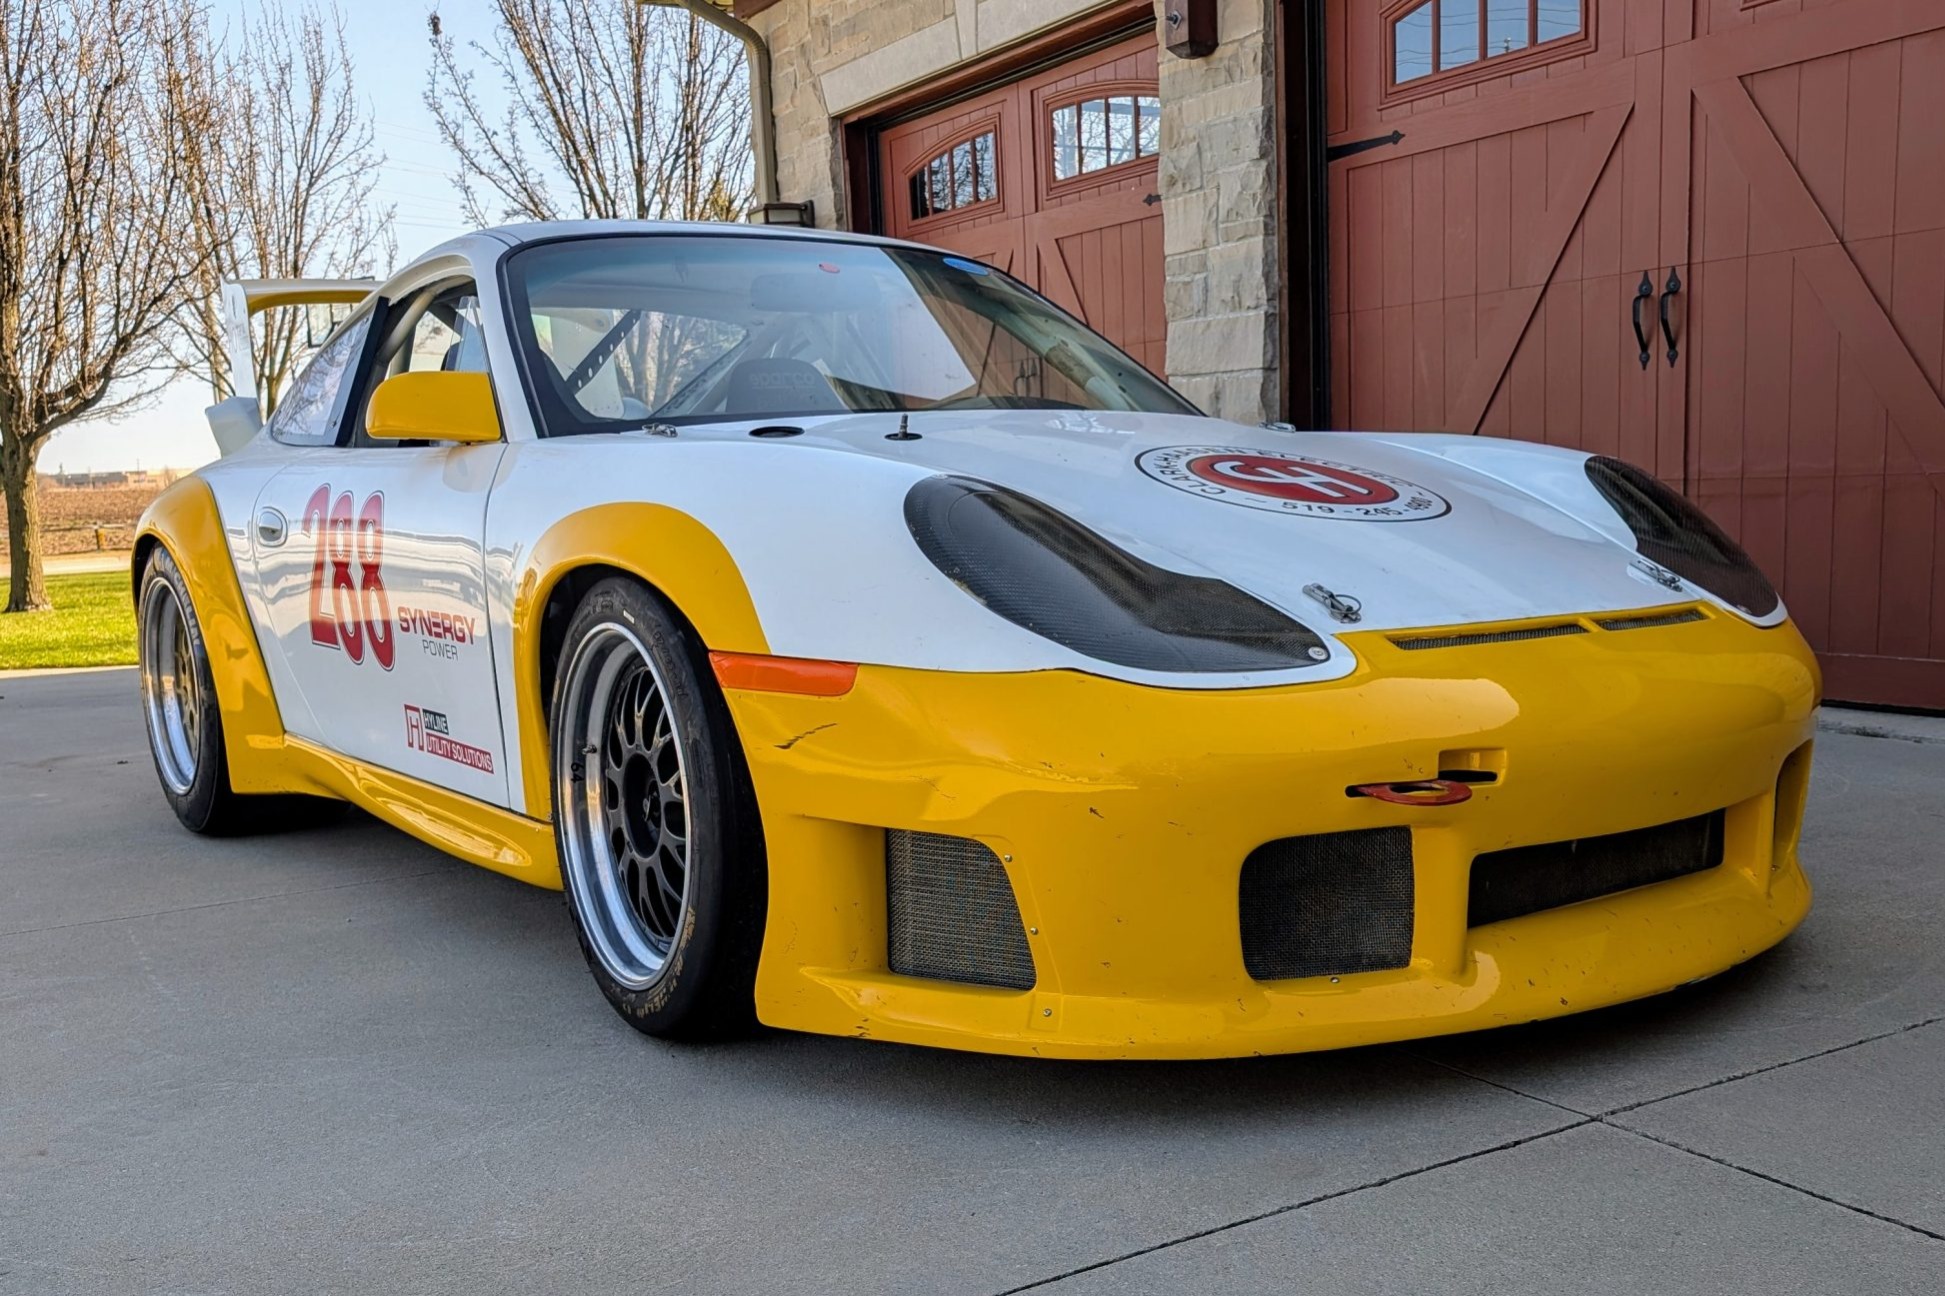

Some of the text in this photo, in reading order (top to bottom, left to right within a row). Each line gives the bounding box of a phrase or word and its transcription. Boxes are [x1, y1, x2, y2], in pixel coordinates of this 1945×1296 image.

[749, 372, 816, 389] sparco
[301, 482, 396, 672] 288
[164, 556, 201, 646] MICHELIN
[397, 606, 476, 645] SYNERGY
[422, 639, 459, 661] POWER
[423, 711, 448, 733] HYLINE
[428, 736, 493, 772] UTILITY SOLUTIONS
